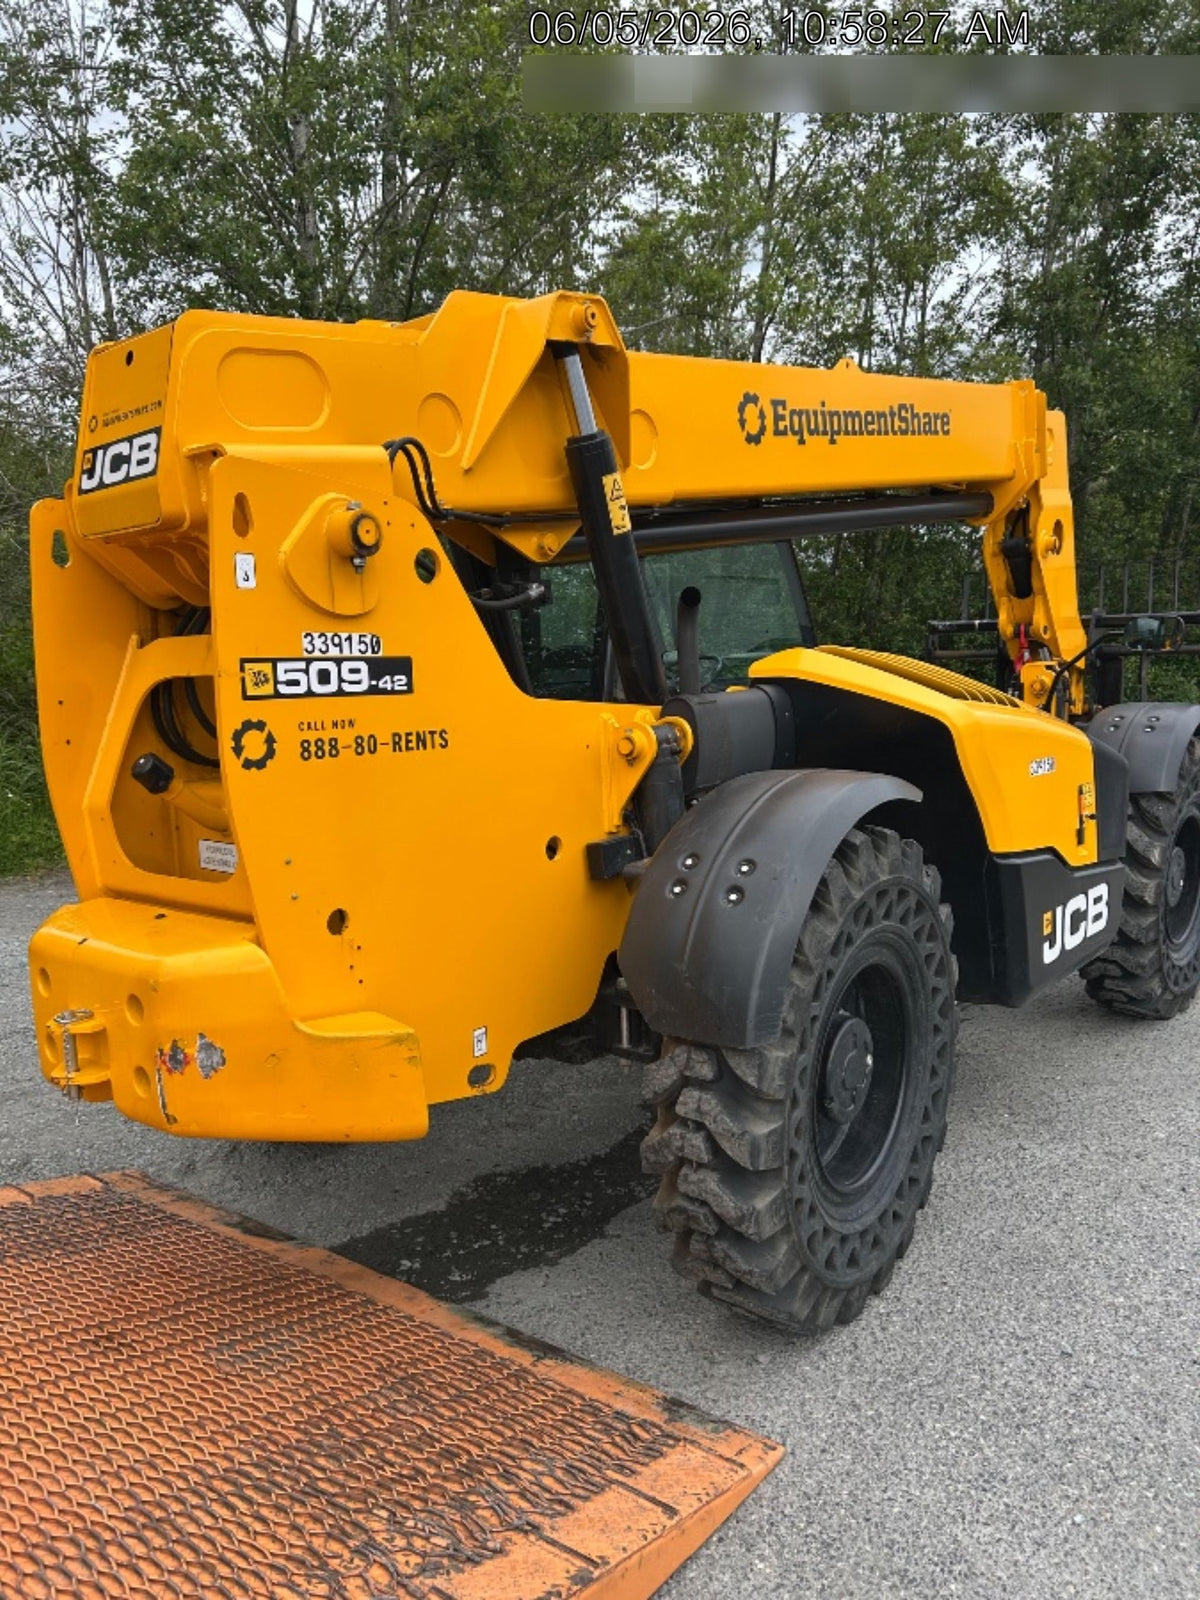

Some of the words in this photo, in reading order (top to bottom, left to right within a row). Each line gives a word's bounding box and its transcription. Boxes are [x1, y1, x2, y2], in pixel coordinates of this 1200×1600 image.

[770, 399, 951, 445] EquipmentShare
[81, 432, 159, 490] JCB
[303, 632, 381, 655] 339150
[276, 660, 408, 695] 509-42
[298, 720, 326, 732] CALL
[331, 718, 356, 730] NOW
[300, 728, 449, 761] 888-80-RENTS
[1043, 883, 1109, 964] JCB
